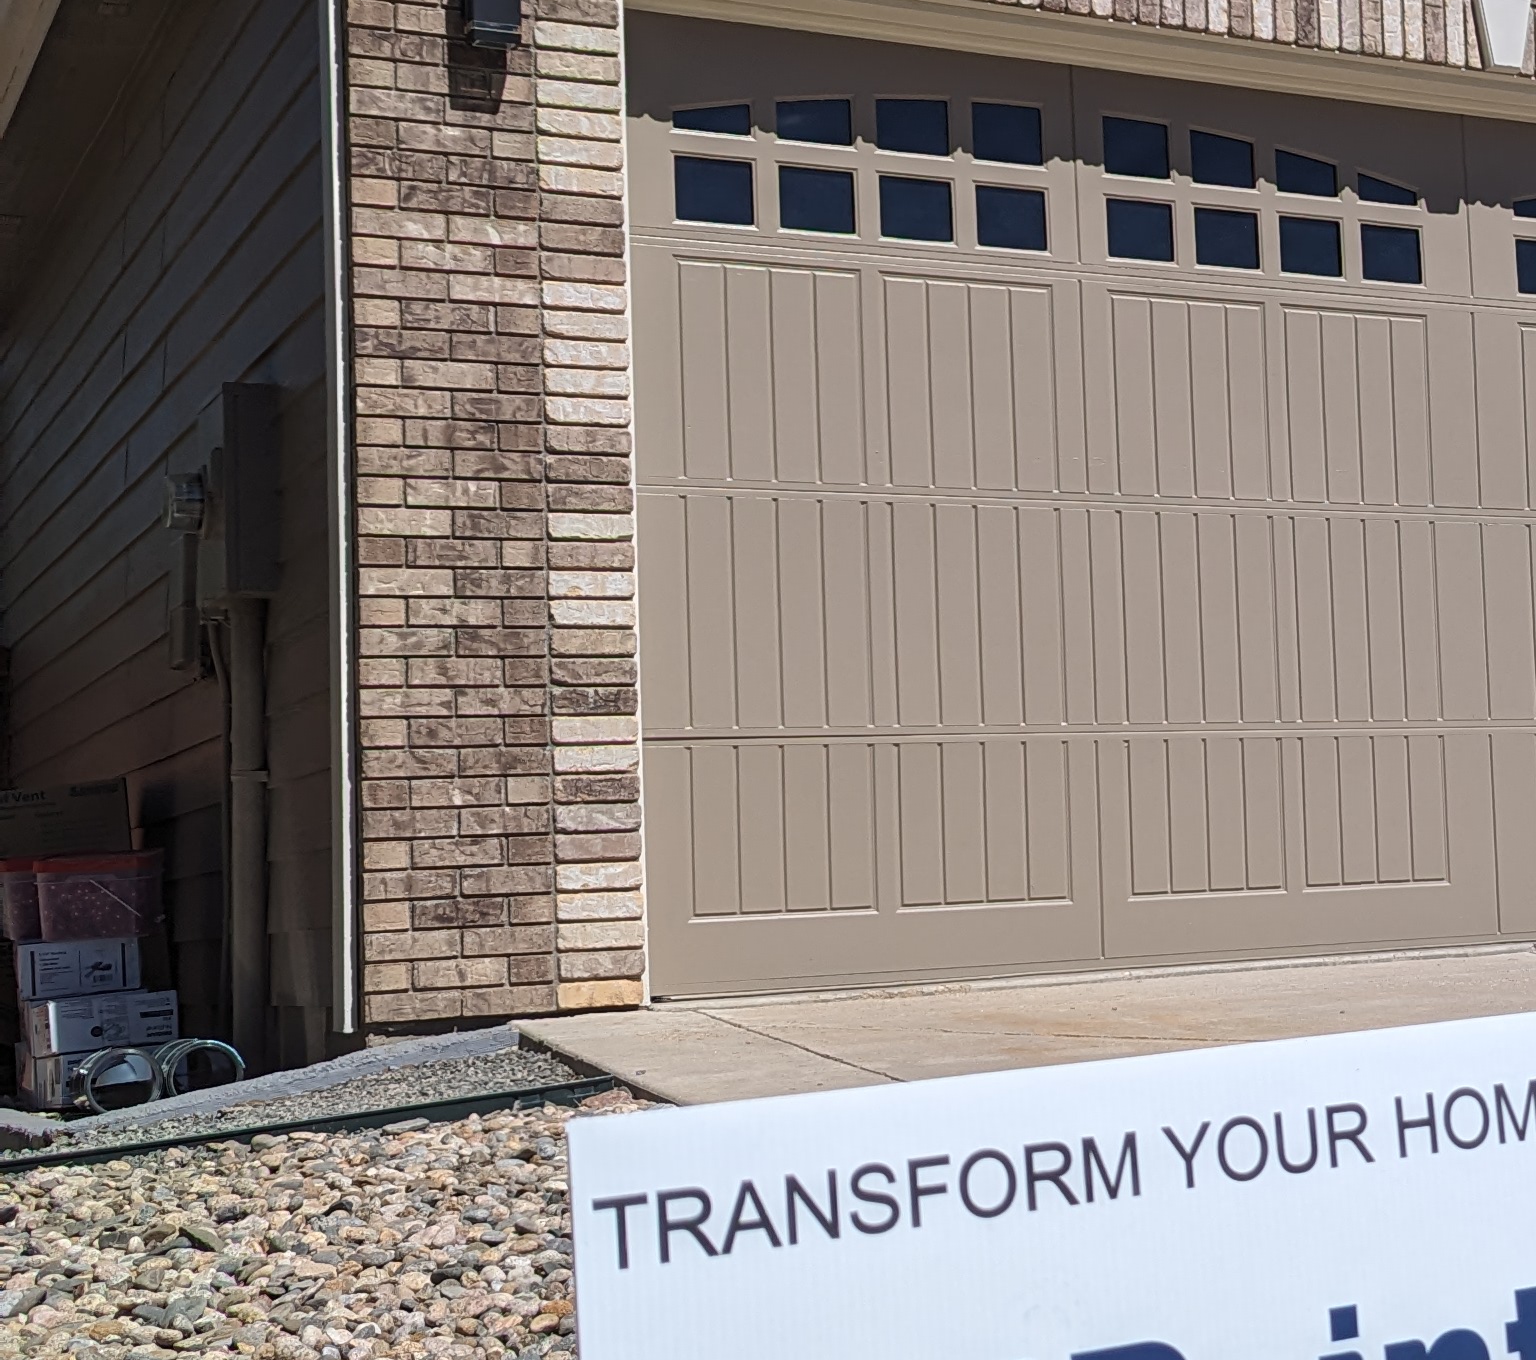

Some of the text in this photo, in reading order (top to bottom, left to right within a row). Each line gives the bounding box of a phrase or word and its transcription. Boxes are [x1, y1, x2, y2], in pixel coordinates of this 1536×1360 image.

[11, 790, 47, 802] Vent
[592, 1132, 1141, 1270] TRANSFORM
[1163, 1105, 1374, 1189] YOUR
